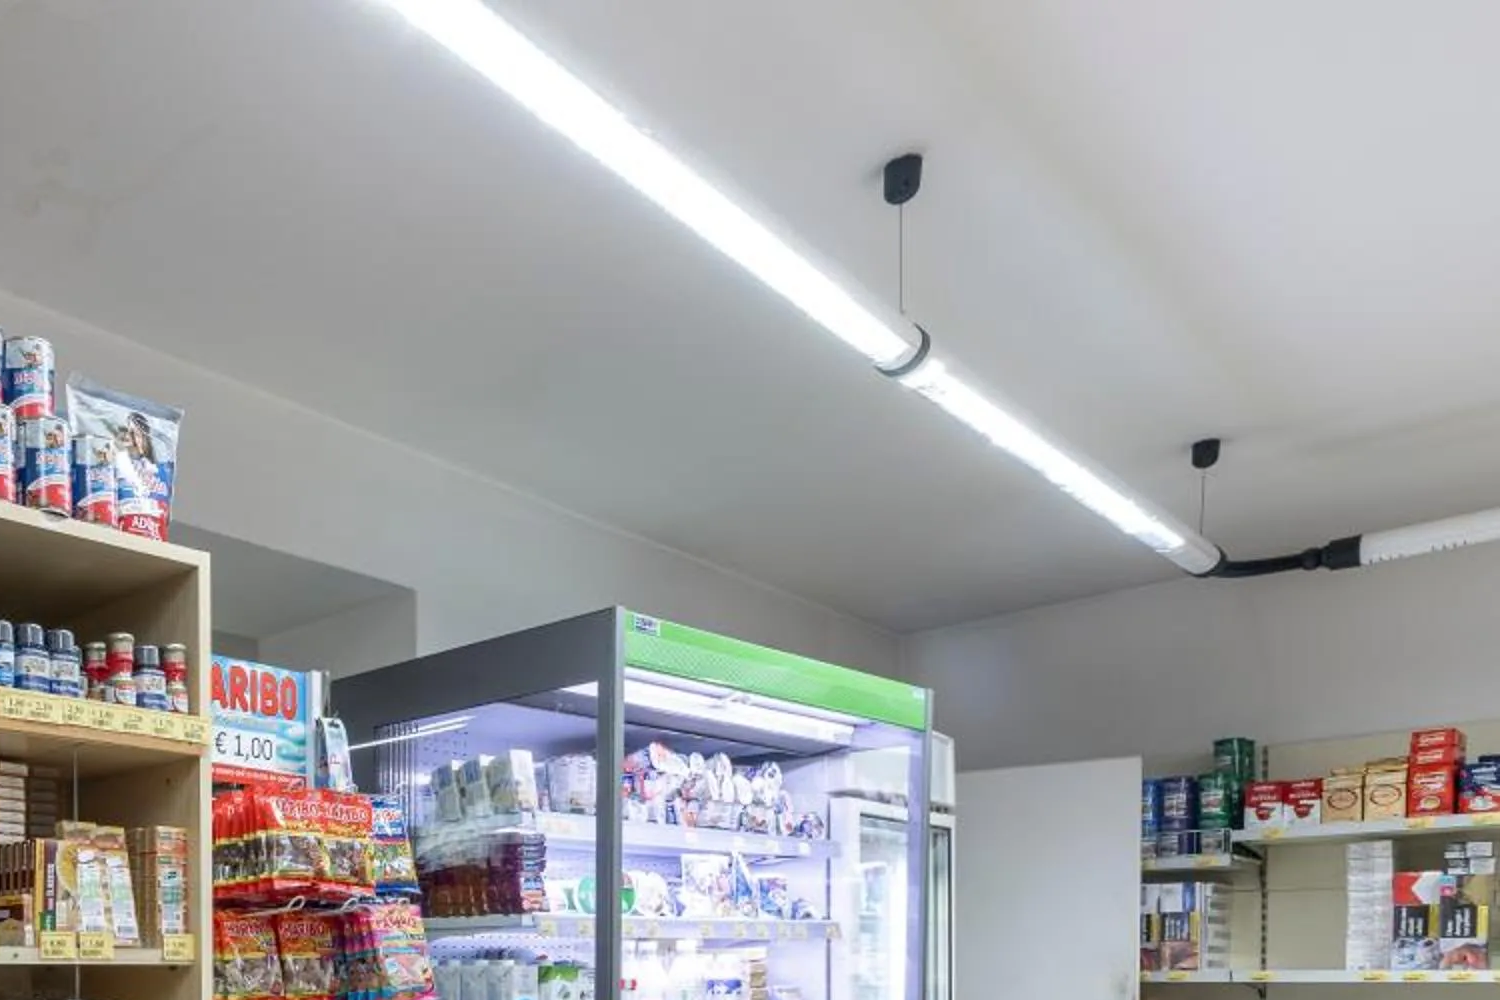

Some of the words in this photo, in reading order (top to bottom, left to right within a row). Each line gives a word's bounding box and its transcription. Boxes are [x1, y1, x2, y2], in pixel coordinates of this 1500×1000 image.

[212, 661, 297, 720] ARIBO
[215, 732, 227, 754] €
[234, 735, 274, 761] 1,00
